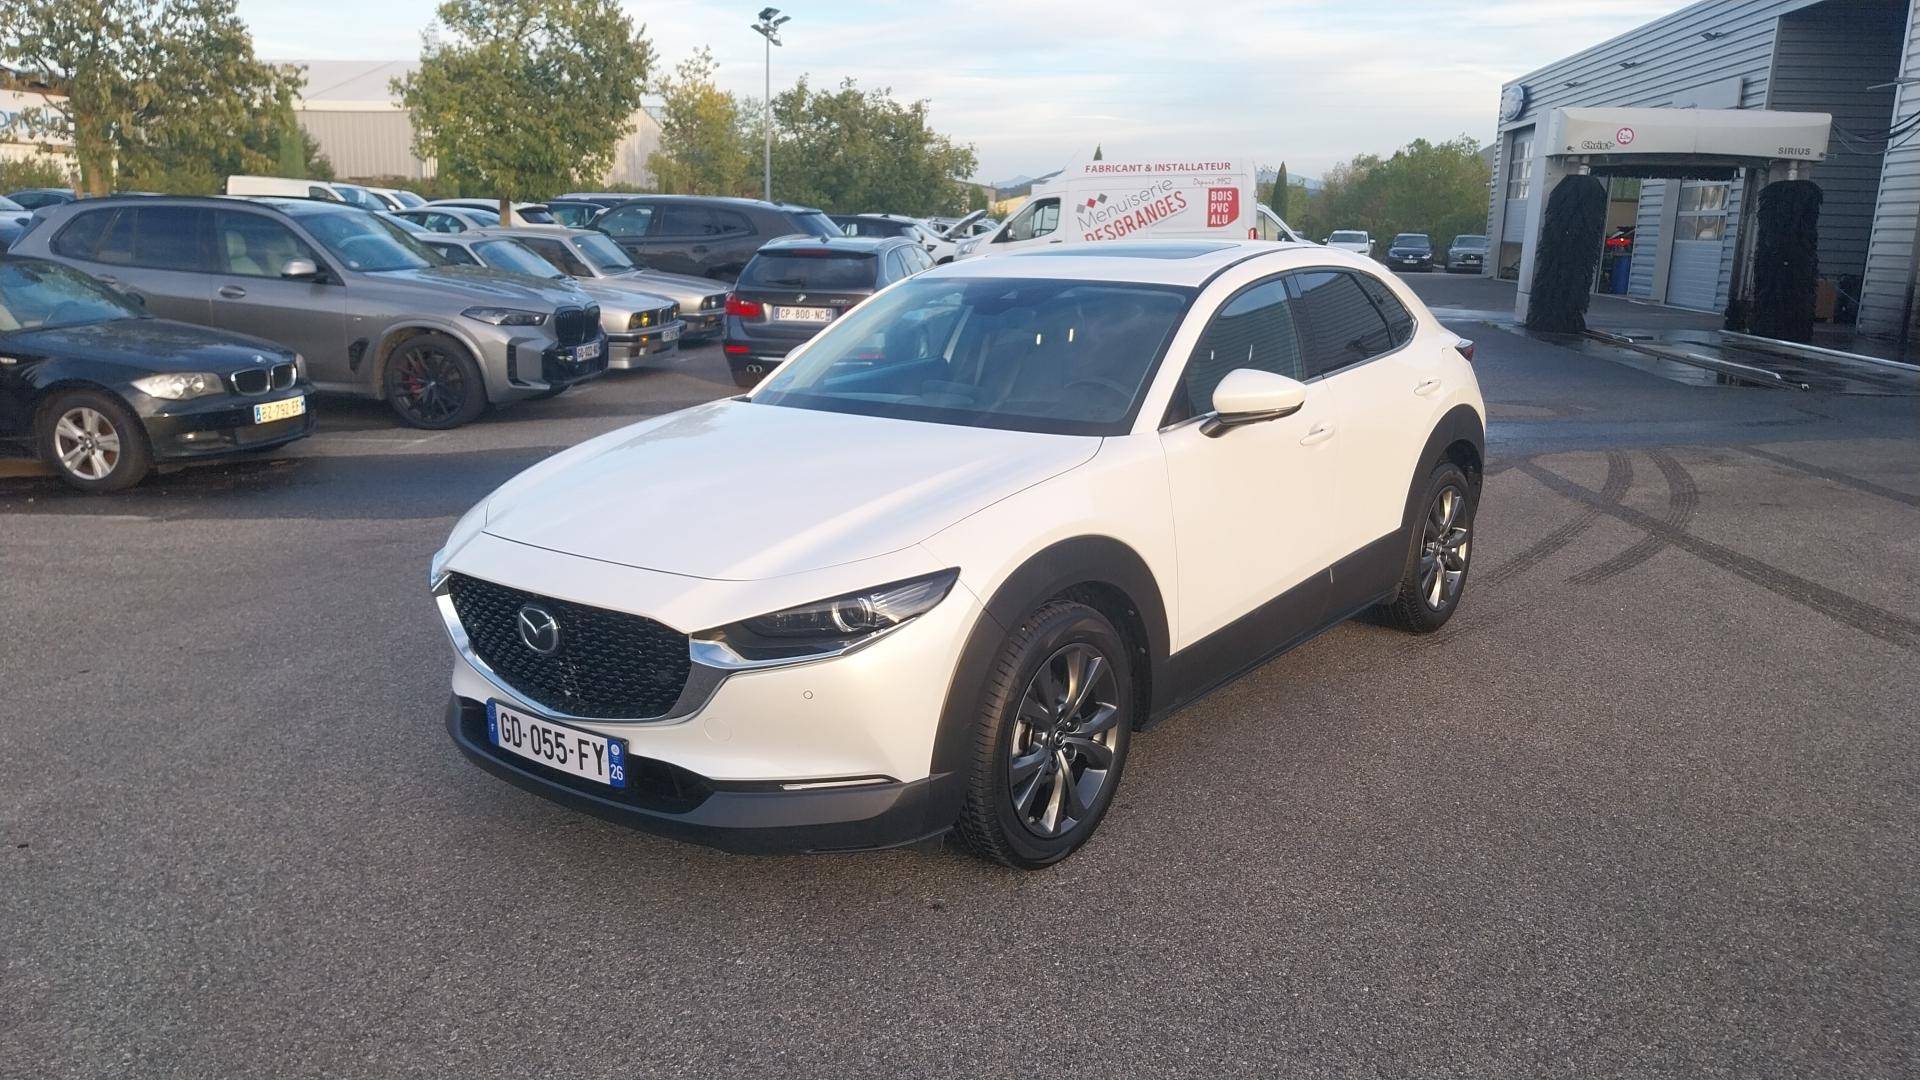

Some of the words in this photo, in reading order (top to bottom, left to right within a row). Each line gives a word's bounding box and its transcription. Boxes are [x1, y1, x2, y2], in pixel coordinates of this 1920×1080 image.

[1777, 146, 1811, 156] SIRIUS
[1084, 164, 1143, 174] FABRICANT
[1144, 163, 1153, 173] &
[1155, 162, 1231, 172] INSTALLATEUR
[1211, 190, 1233, 202] BOIS
[1077, 179, 1173, 232] Menuiserie
[1210, 202, 1229, 213] PVC
[1210, 214, 1229, 225] ALU
[500, 712, 605, 776] GD-055-FY
[610, 764, 623, 781] 26
